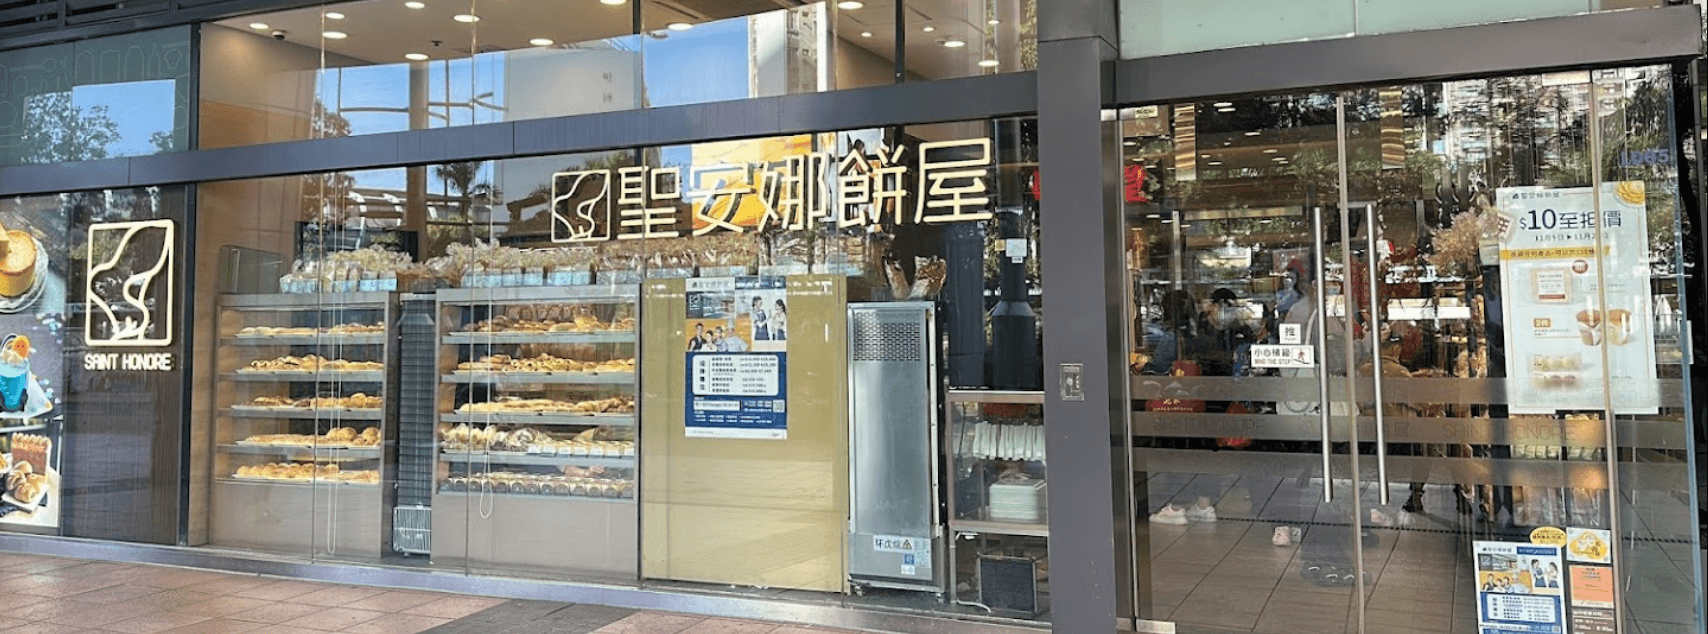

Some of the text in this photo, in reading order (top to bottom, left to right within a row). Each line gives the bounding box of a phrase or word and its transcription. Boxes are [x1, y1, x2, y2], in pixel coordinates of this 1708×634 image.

[617, 137, 993, 240] 聖安娜餅屋
[1284, 326, 1296, 337] 推
[1254, 347, 1291, 357] 小心梯級
[84, 352, 172, 371] SAINT HONORE
